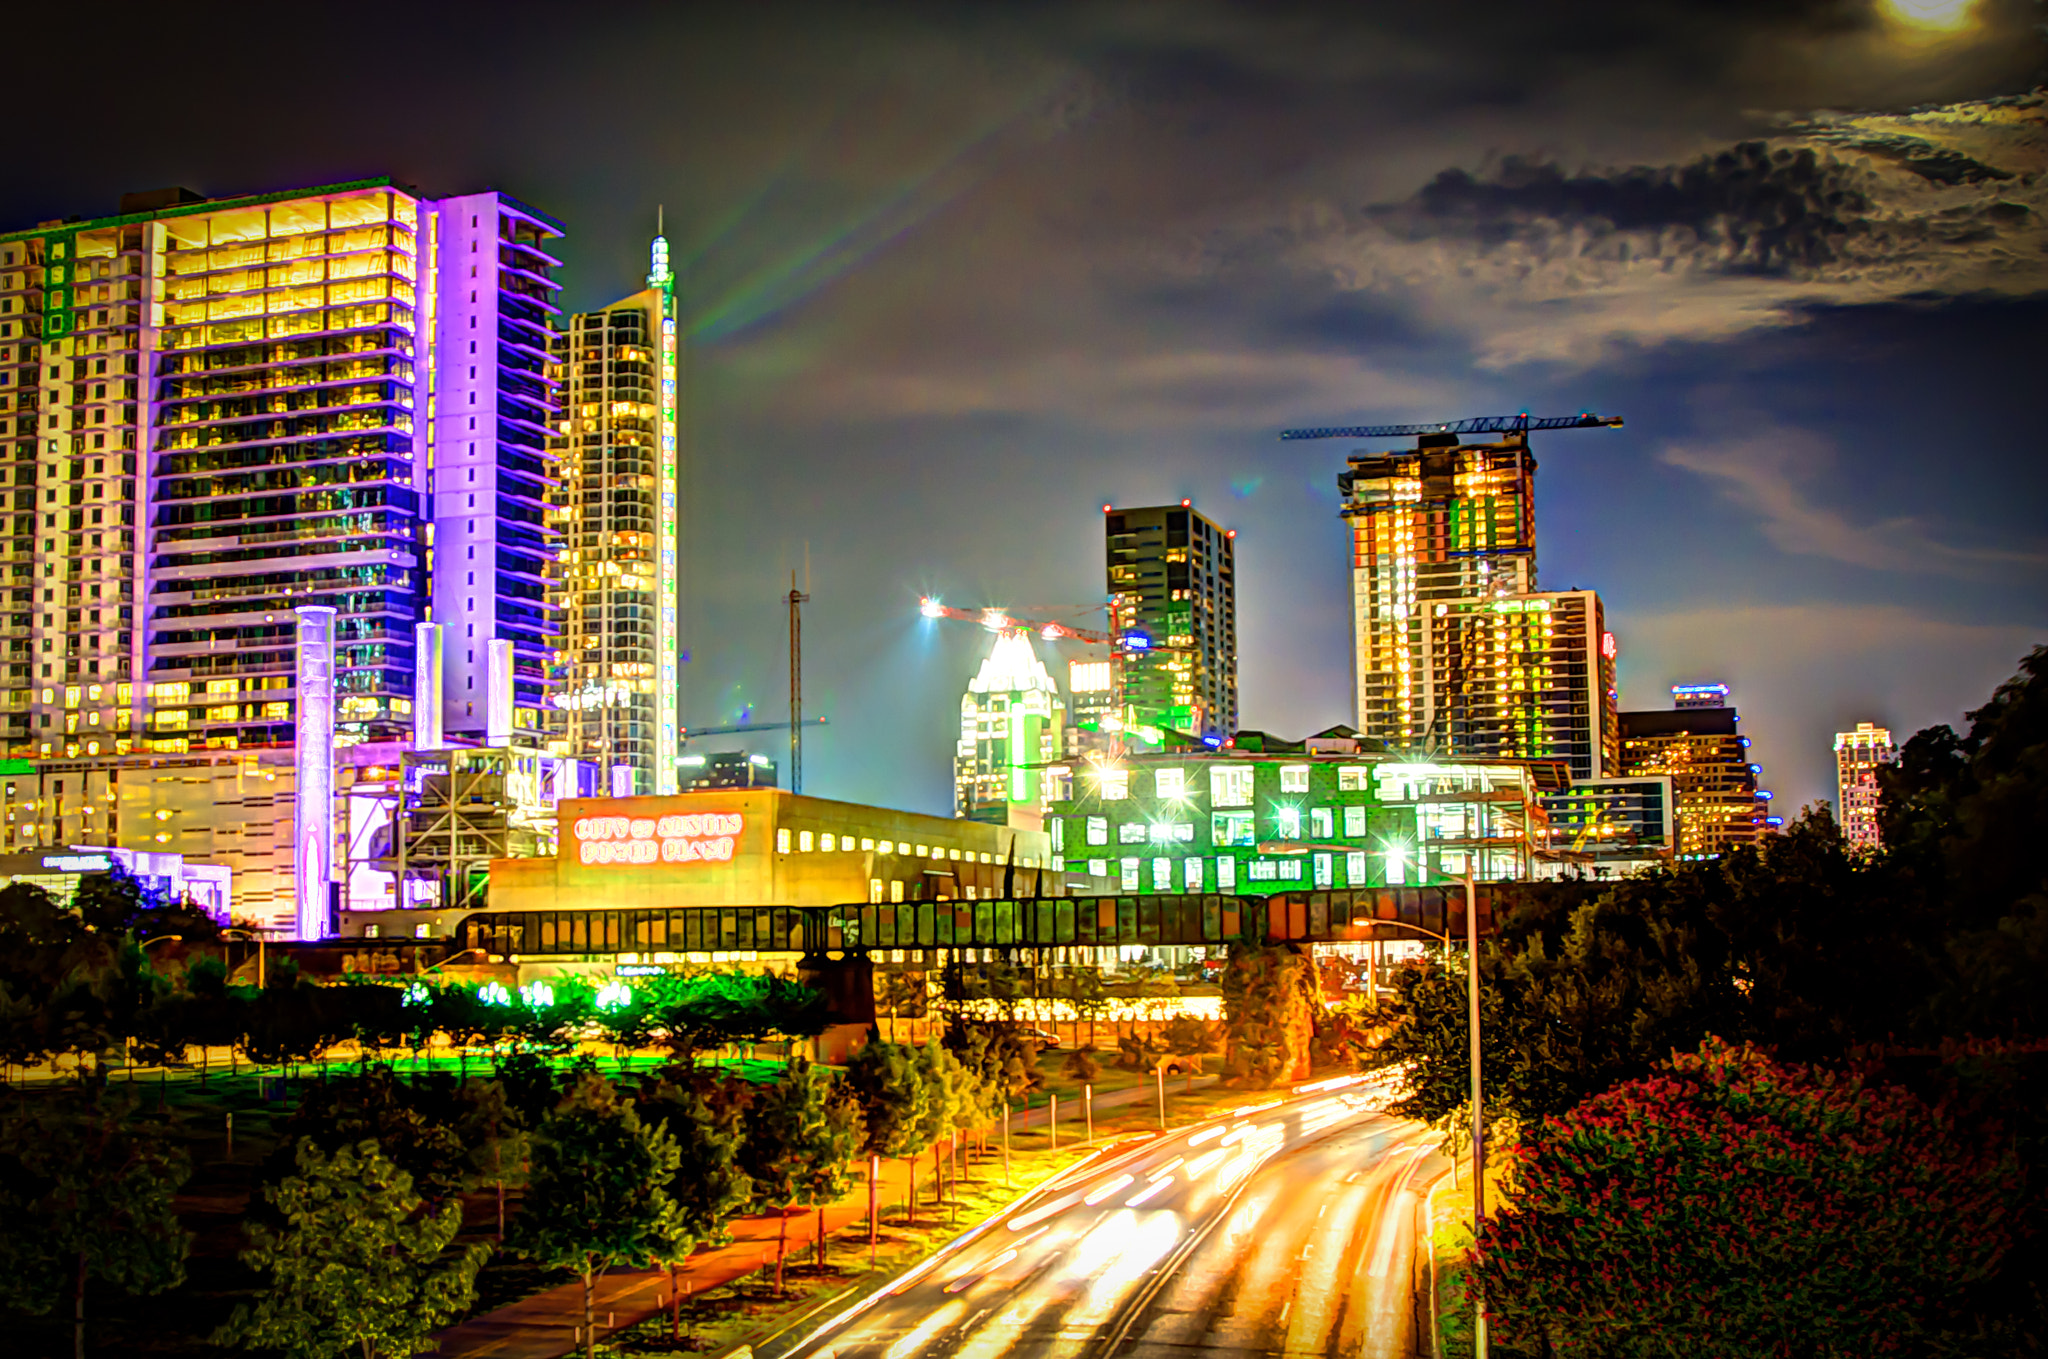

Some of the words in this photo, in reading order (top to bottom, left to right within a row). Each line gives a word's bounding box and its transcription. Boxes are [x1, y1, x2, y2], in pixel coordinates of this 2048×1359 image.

[575, 818, 629, 839] CITY
[658, 814, 742, 837] AUSTIN
[581, 841, 658, 863] POWER
[662, 838, 734, 861] PLANT
